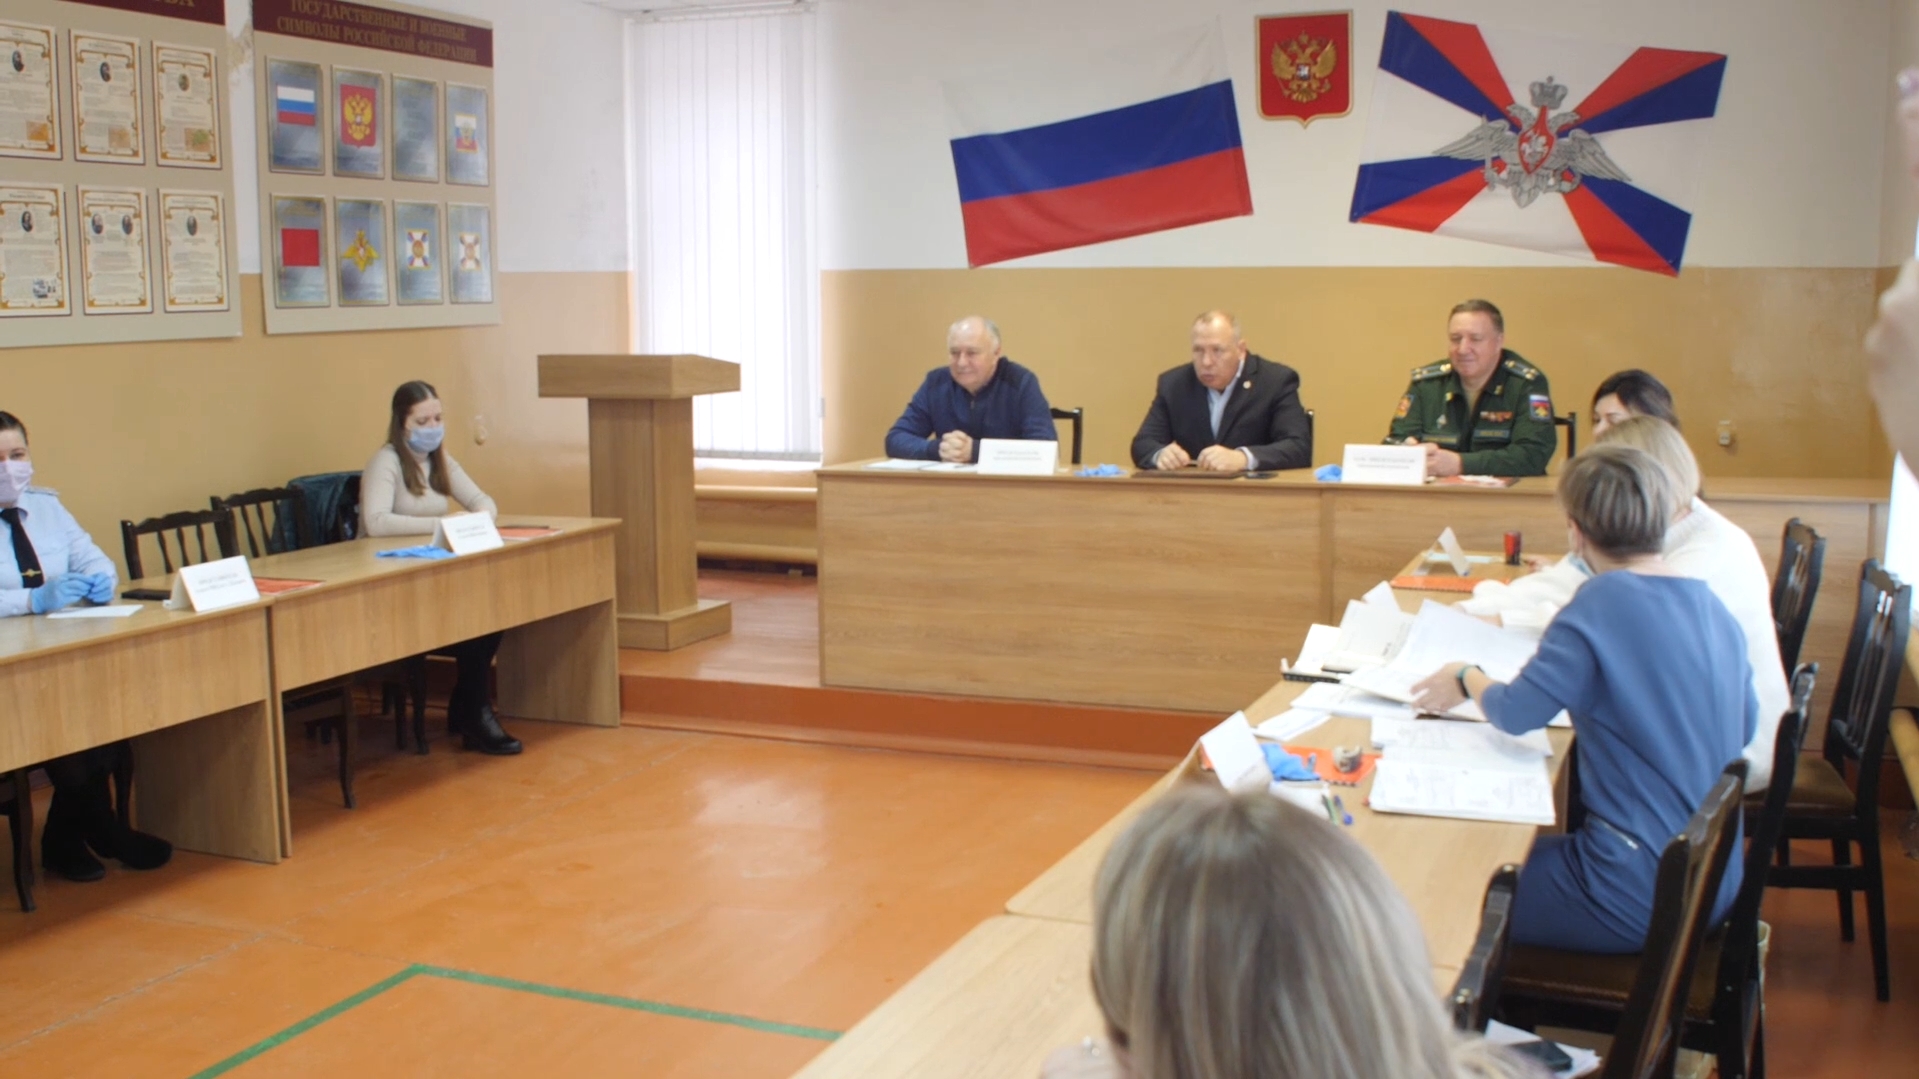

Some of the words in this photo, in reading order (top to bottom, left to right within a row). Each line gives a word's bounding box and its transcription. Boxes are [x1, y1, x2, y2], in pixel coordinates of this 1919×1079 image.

[276, 16, 340, 40] СИМВОЛЫ
[343, 26, 415, 52] РОССИЙСКОЙ
[409, 17, 418, 33] И
